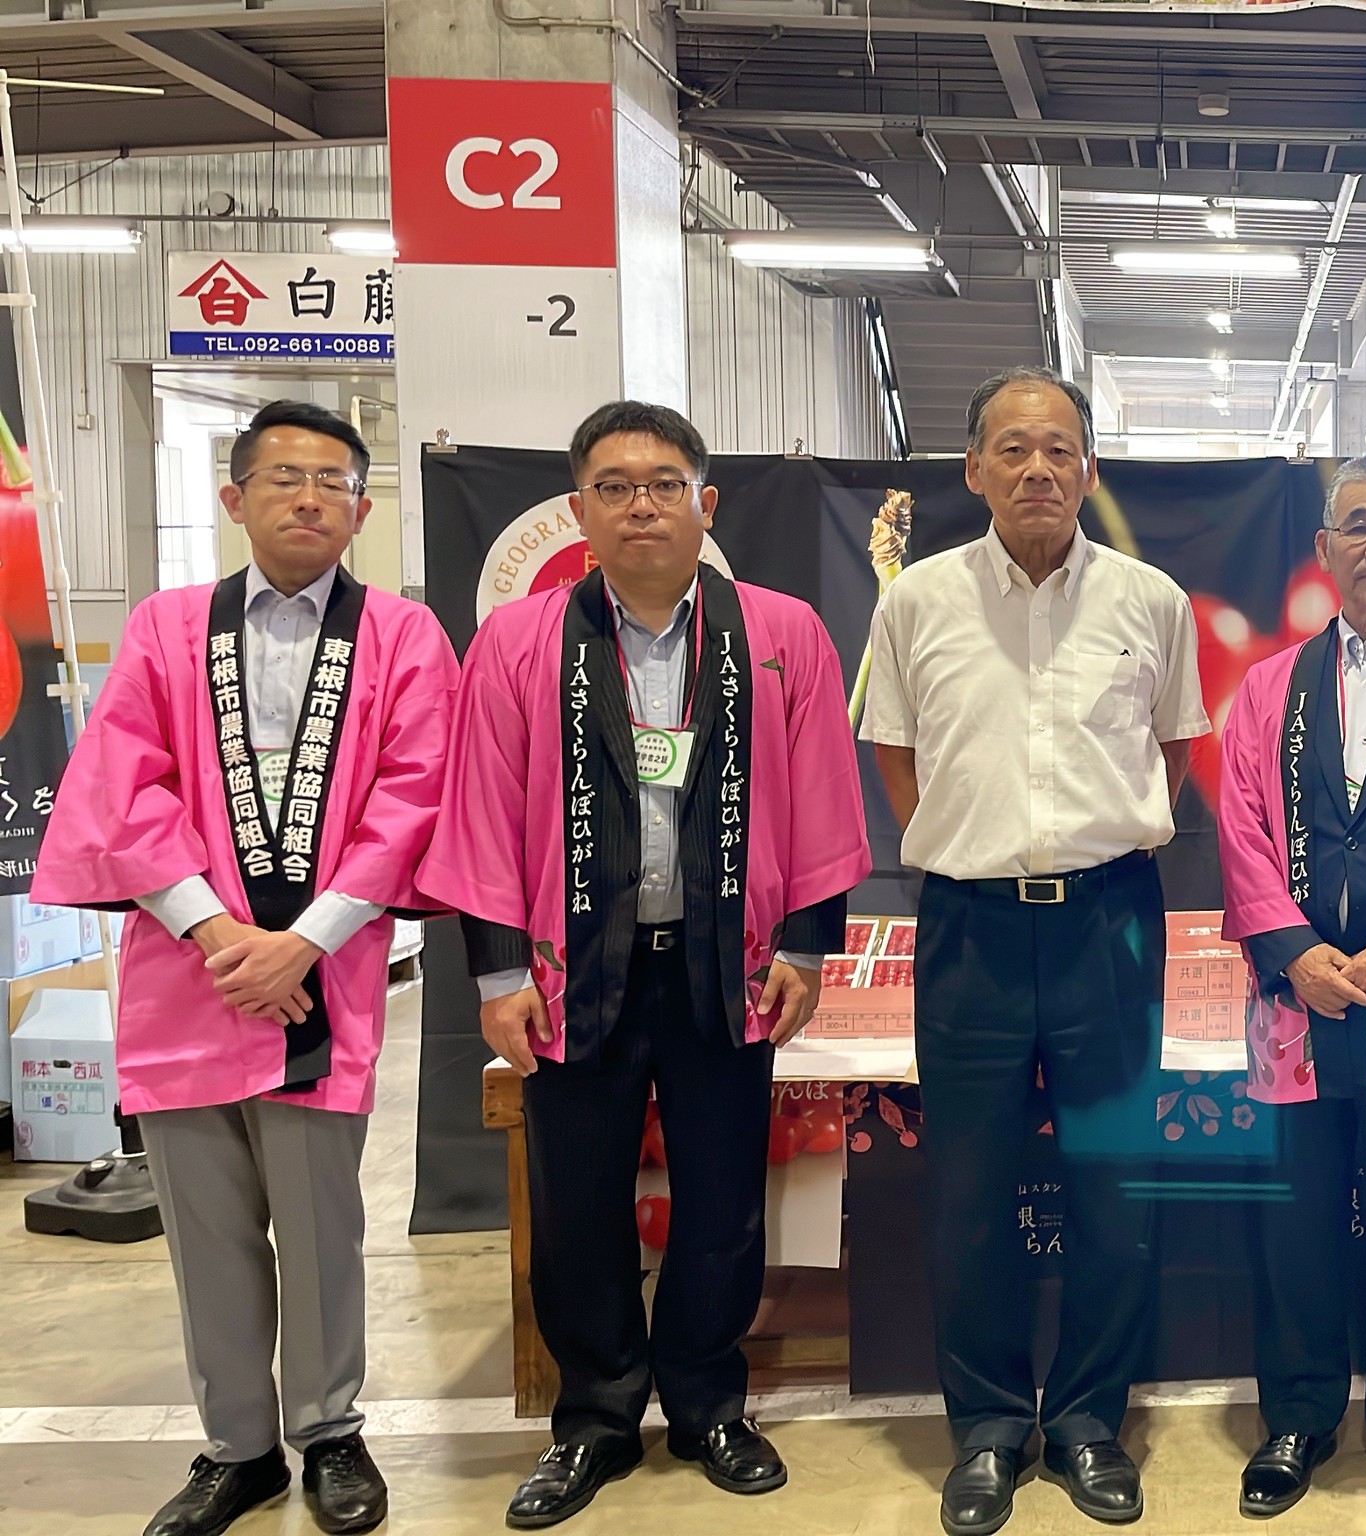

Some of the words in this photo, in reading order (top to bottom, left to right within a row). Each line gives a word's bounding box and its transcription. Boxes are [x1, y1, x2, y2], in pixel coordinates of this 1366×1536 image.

[445, 136, 562, 210] C2
[204, 337, 380, 354] TEL.092-661-0088
[526, 294, 578, 336] -2
[494, 511, 579, 594] GEOGRA
[210, 631, 274, 878] 東根市農業協同組合
[281, 637, 354, 883] 東根市農業協同組合
[569, 643, 595, 914] JAさくらんぼひがしね
[719, 631, 745, 898] JAさくらんぼひがしね
